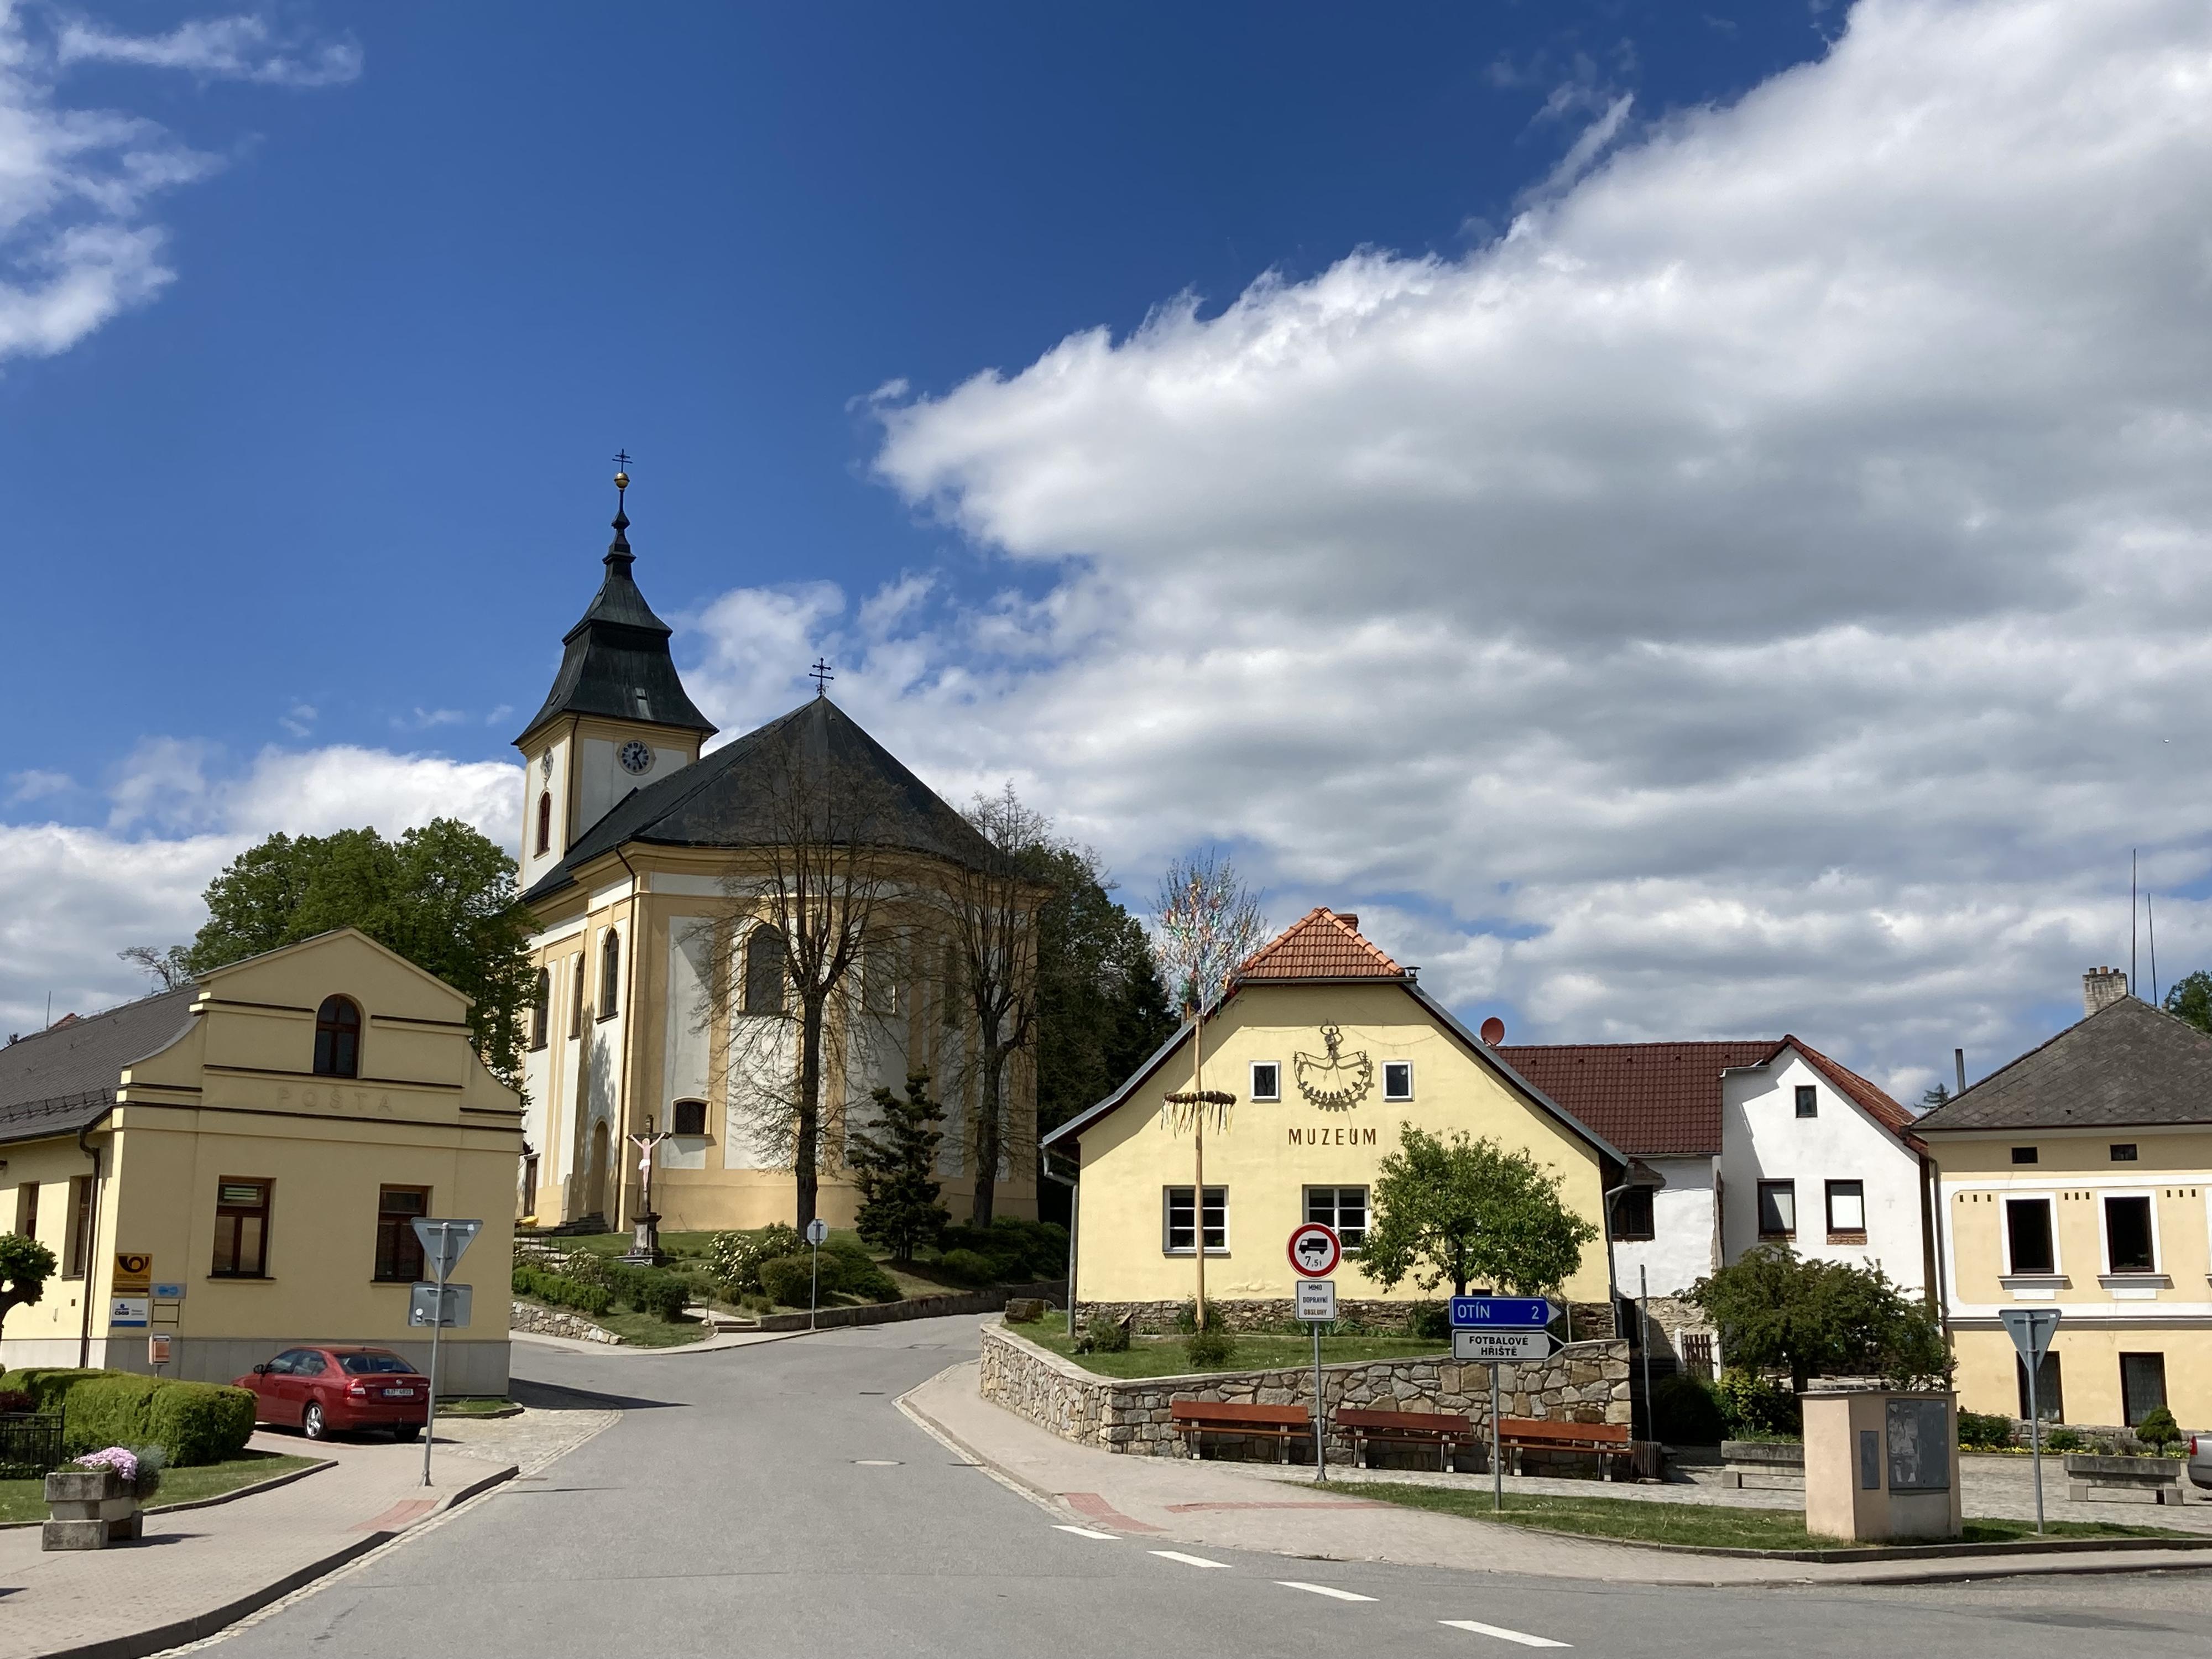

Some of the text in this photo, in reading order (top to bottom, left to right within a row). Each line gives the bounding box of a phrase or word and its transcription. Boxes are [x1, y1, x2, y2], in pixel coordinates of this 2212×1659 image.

[278, 1084, 393, 1112] POŠTA
[1288, 1128, 1376, 1145] MUZEUM
[1457, 1301, 1540, 1319] OTÍN 2
[1469, 1335, 1528, 1345] FOTBALOVÉ
[1481, 1345, 1517, 1356] HŘIŠTĚ
